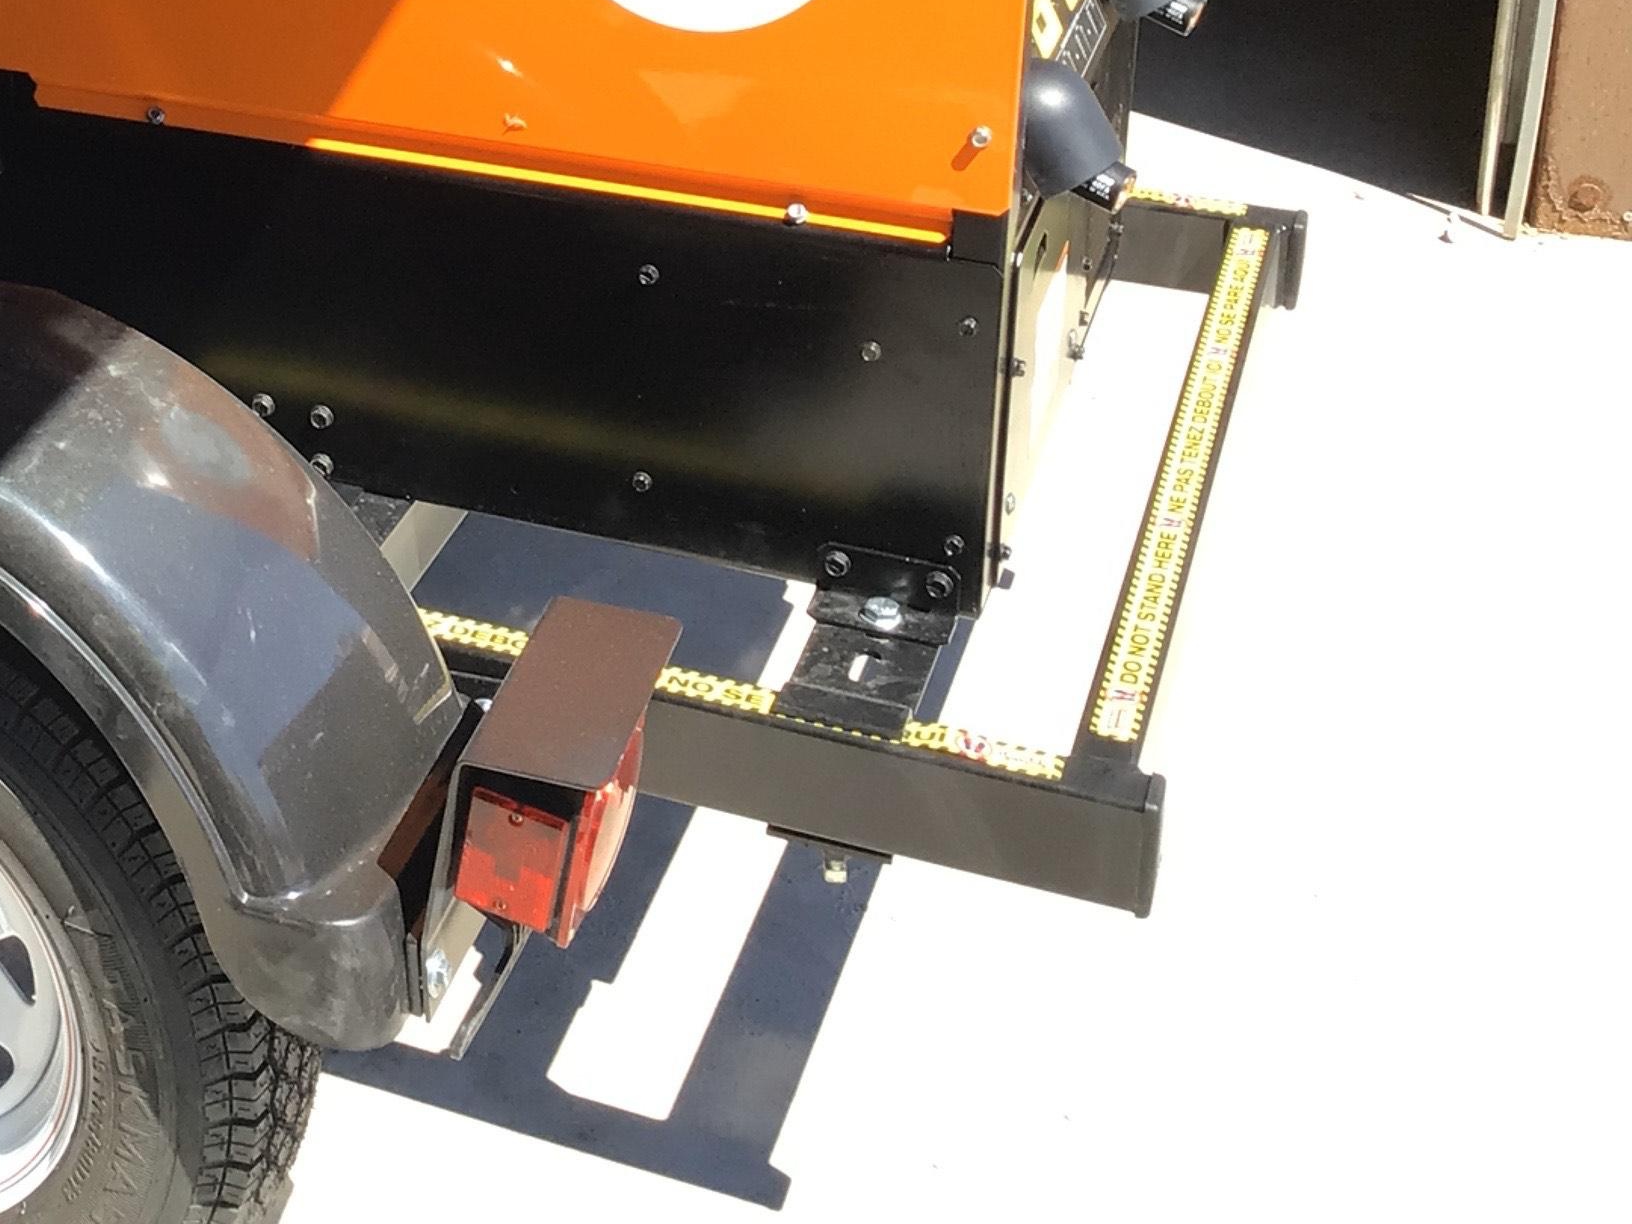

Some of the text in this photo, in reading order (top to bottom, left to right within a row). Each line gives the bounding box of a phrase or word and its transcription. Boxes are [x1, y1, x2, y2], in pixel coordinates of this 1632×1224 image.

[1223, 282, 1244, 310] PARE
[1218, 309, 1237, 327] SE
[1214, 326, 1232, 345] NO
[1191, 375, 1219, 426] DEBOUT
[1180, 425, 1205, 464] TENEZ
[1173, 465, 1195, 493] PAS
[1167, 491, 1186, 514] NE
[1120, 531, 1178, 685] DO NOT STAND HERE
[667, 673, 767, 707] NO SE
